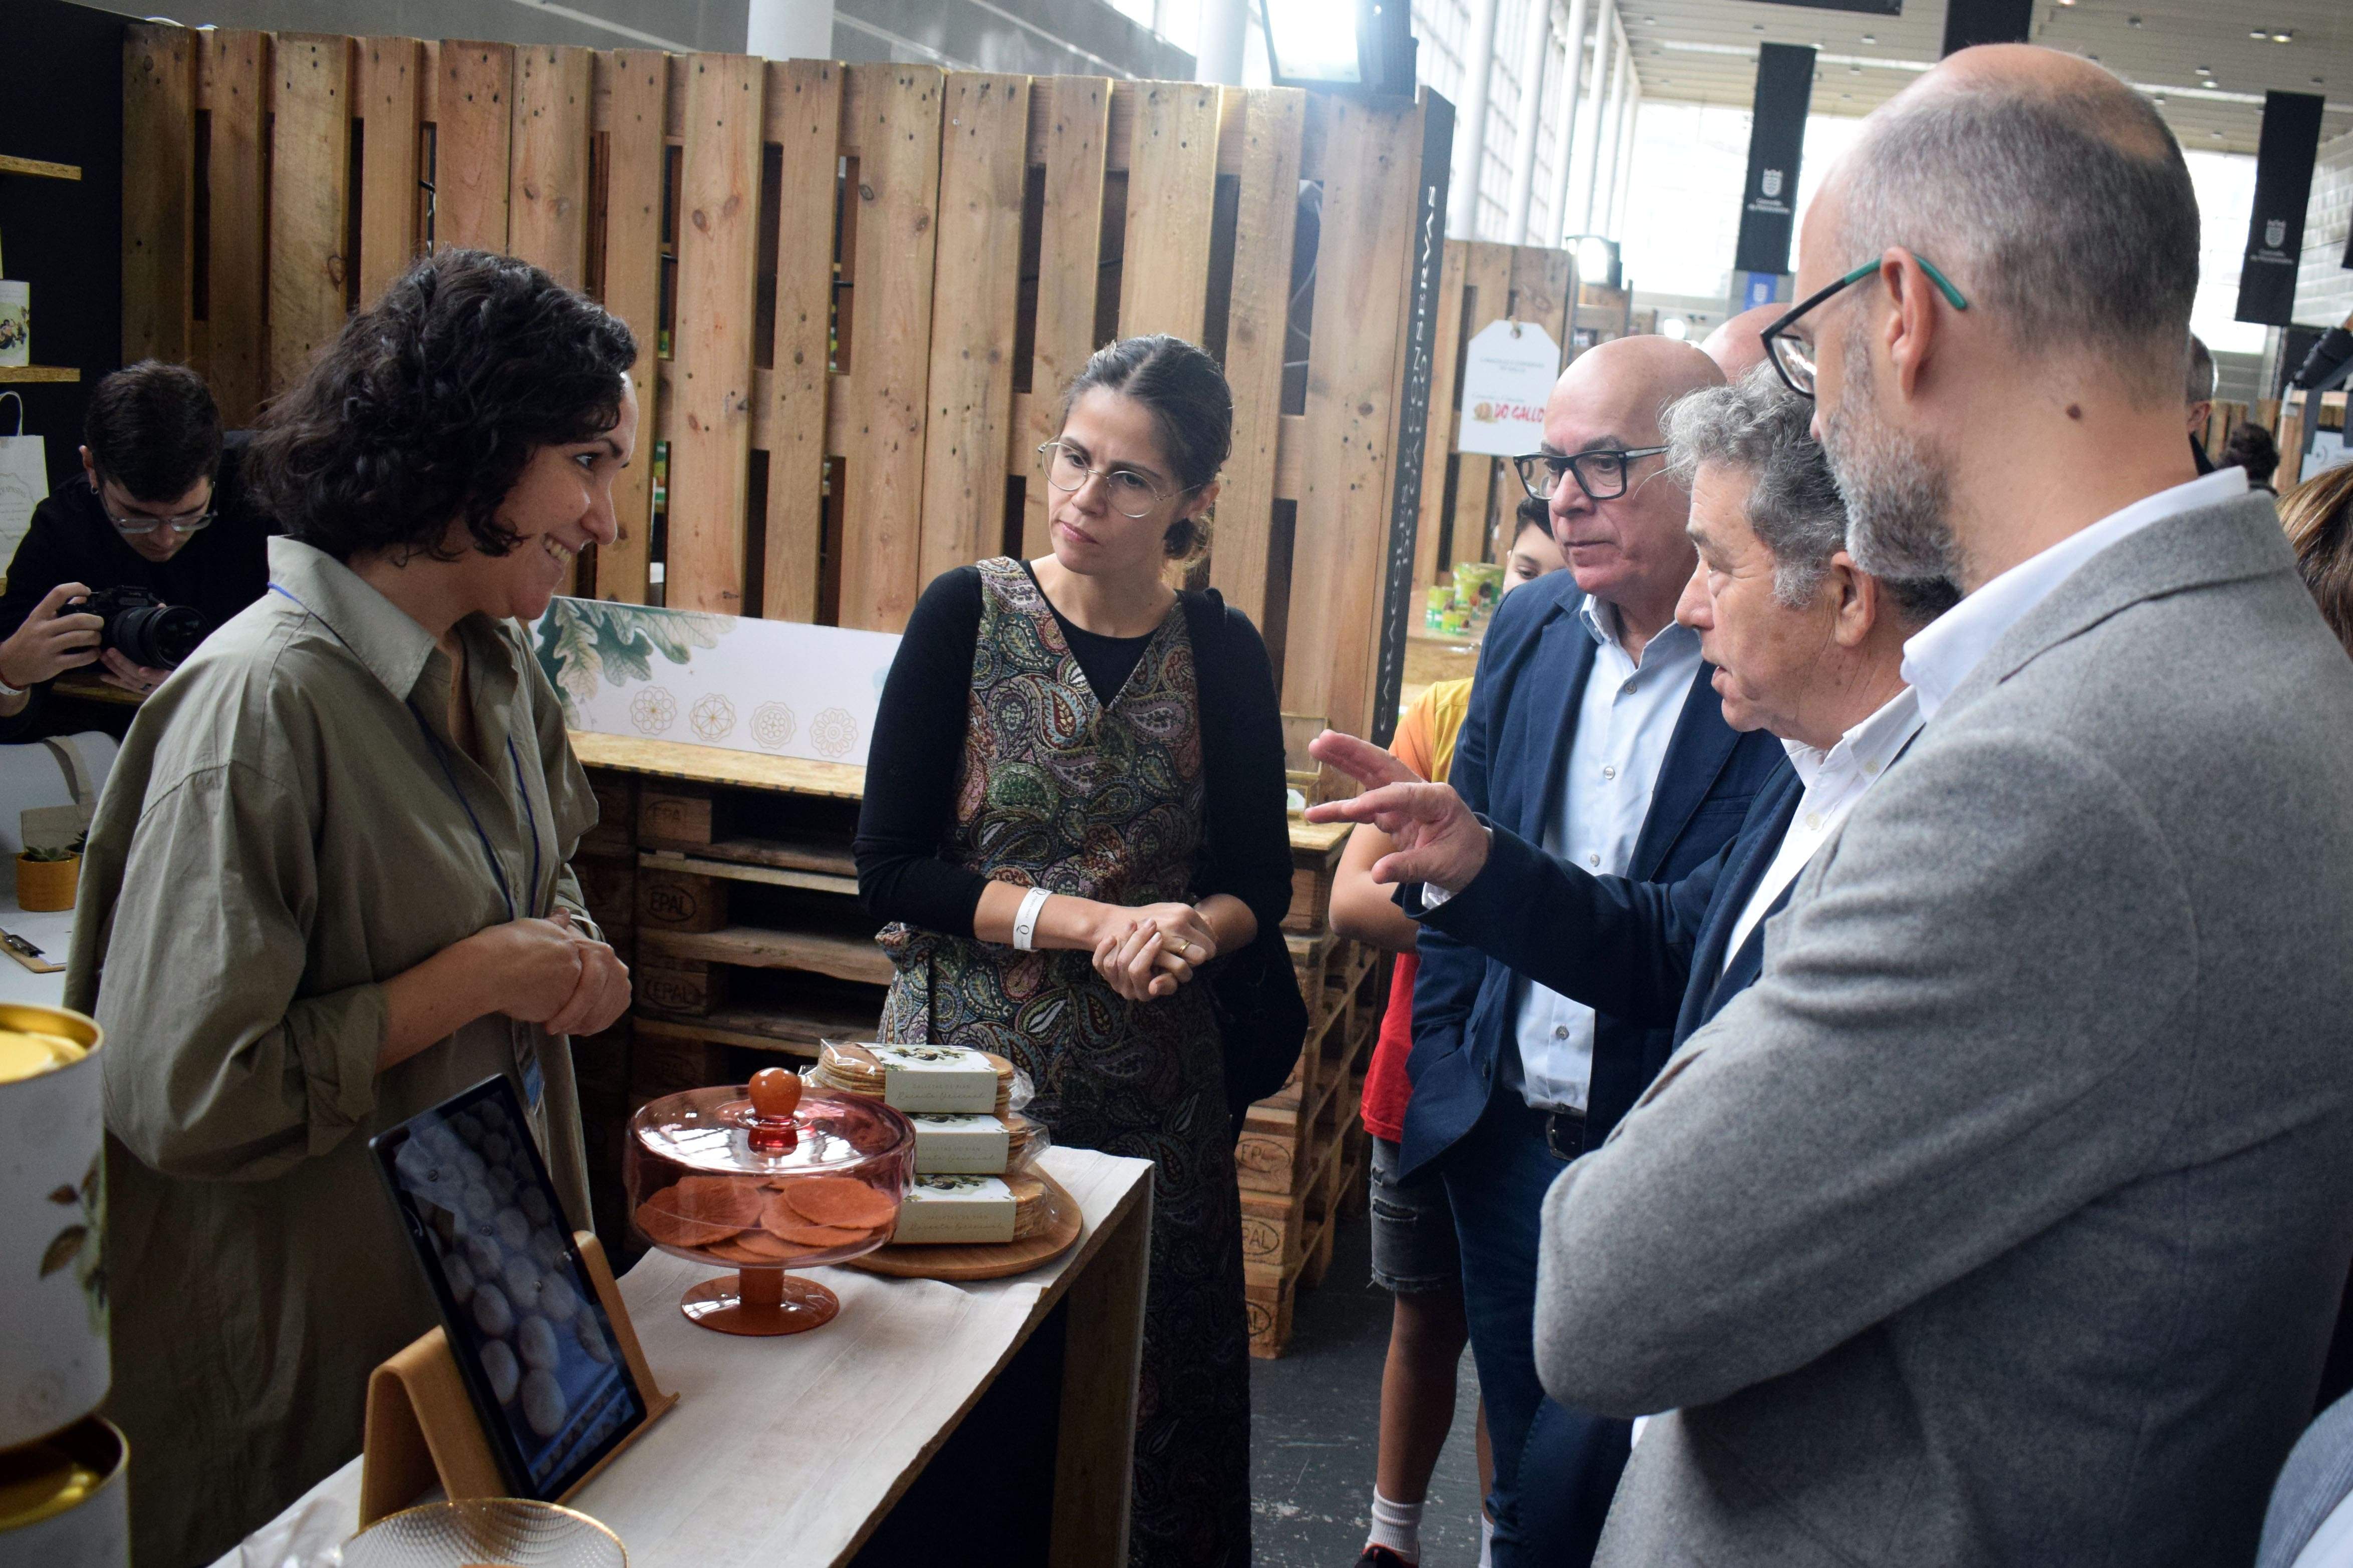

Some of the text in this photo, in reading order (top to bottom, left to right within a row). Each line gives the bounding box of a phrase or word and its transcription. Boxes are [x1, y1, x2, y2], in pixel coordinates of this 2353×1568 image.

[1380, 185, 1436, 730] CARACOLES E CONSERVAS
[1402, 354, 1426, 564] DO GALLO
[1495, 403, 1544, 422] DO GALLO
[651, 892, 688, 916] EPAL
